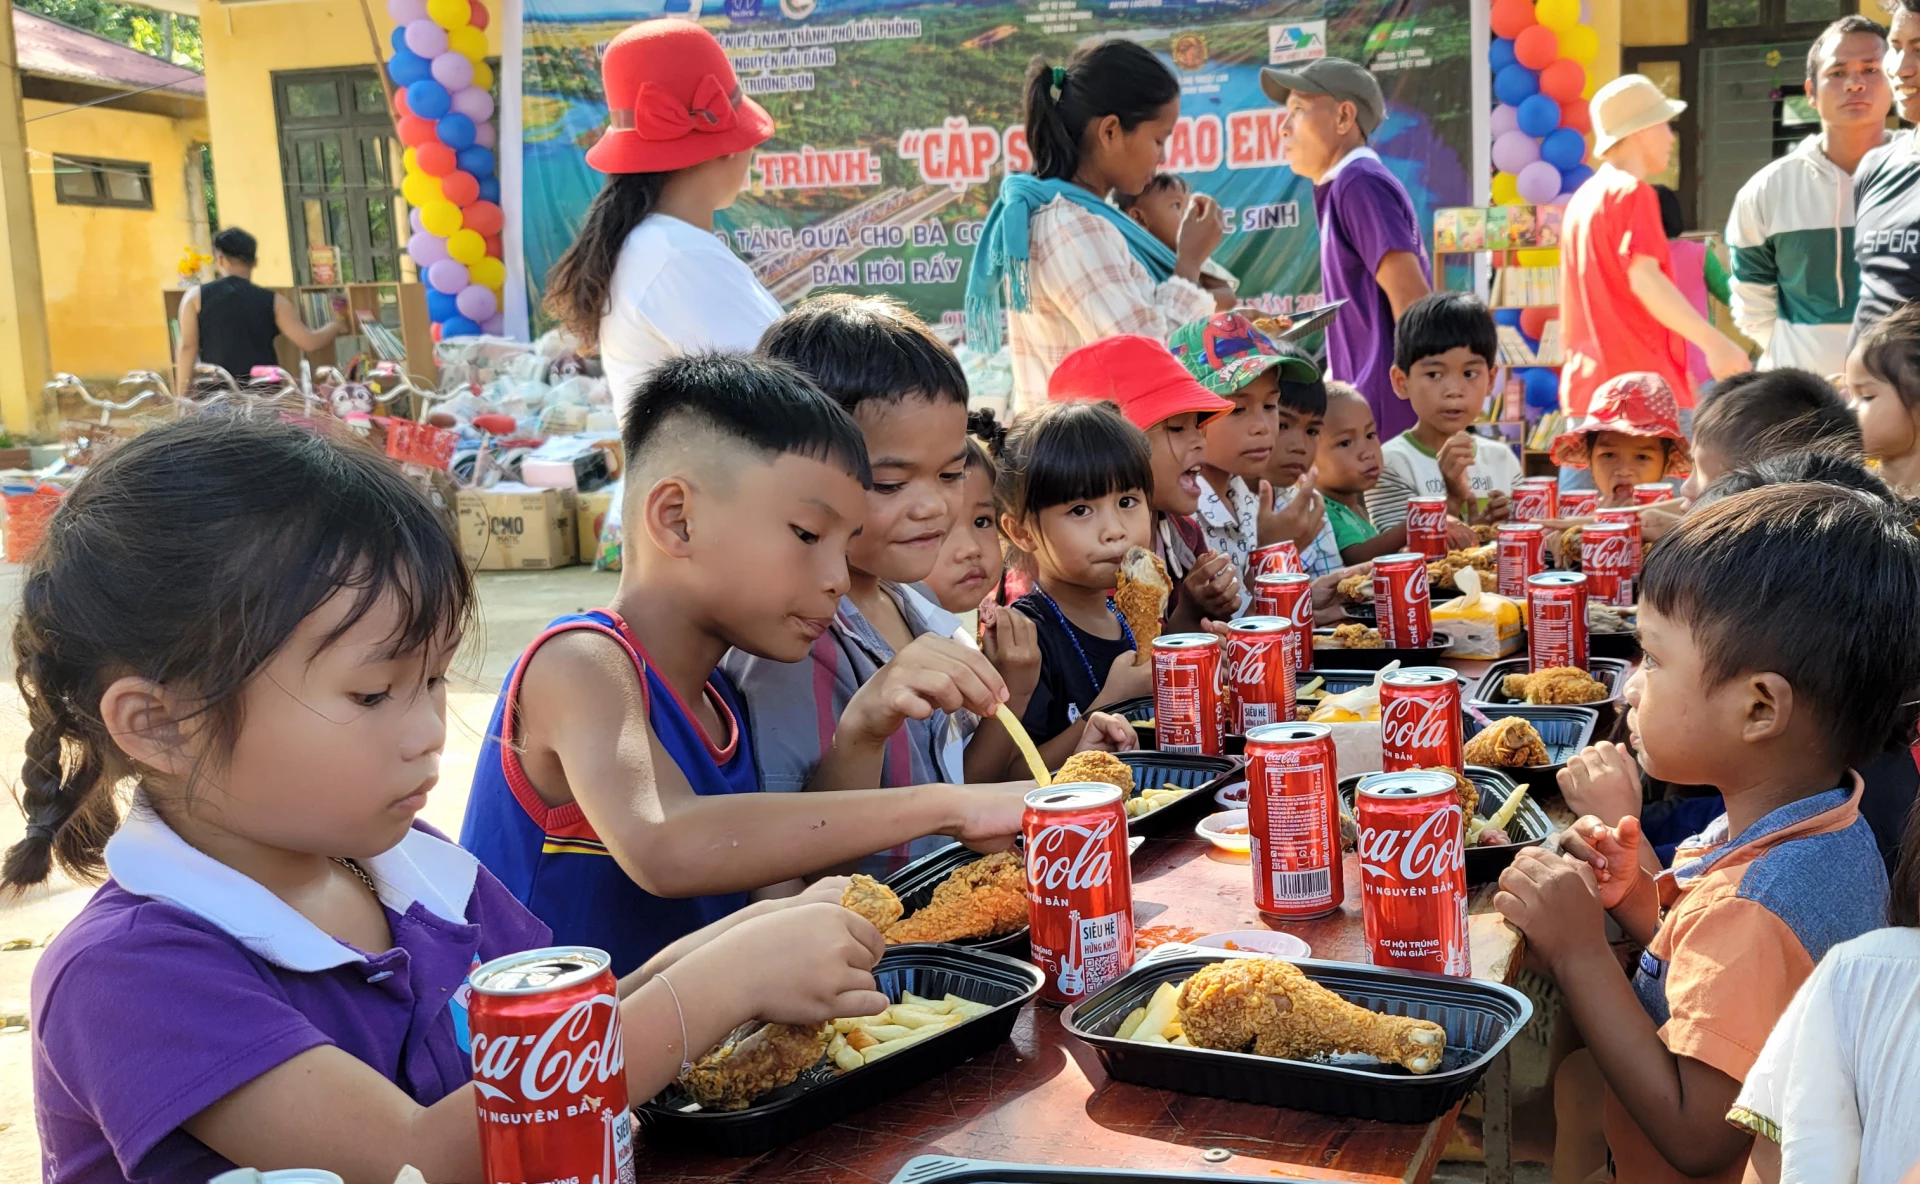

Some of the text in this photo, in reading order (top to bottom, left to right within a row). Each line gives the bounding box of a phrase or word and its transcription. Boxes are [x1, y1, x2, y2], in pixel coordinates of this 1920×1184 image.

[762, 32, 788, 46] NAM
[791, 26, 828, 45] THÀNH
[758, 147, 881, 185] TRÌNH:
[736, 224, 793, 255] TẶNG
[800, 222, 851, 249] QUÀ
[860, 225, 905, 247] CHO
[914, 219, 946, 246] BÀ
[956, 222, 984, 246] CO
[1243, 203, 1298, 231] SINH
[813, 256, 859, 285] BẢN
[490, 516, 524, 535] OMO
[1394, 751, 1413, 761] BẢN
[1365, 881, 1454, 897] VỊ NGUYÊN BẢN
[1045, 895, 1069, 907] BẢN
[1083, 917, 1116, 940] SIÊU HÈ
[1380, 938, 1439, 950] CƠ HỘI TRÚNG
[1389, 948, 1427, 958] VẠN GIẢI
[478, 1106, 488, 1123] VỊ
[490, 1109, 560, 1125] NGUYÊN
